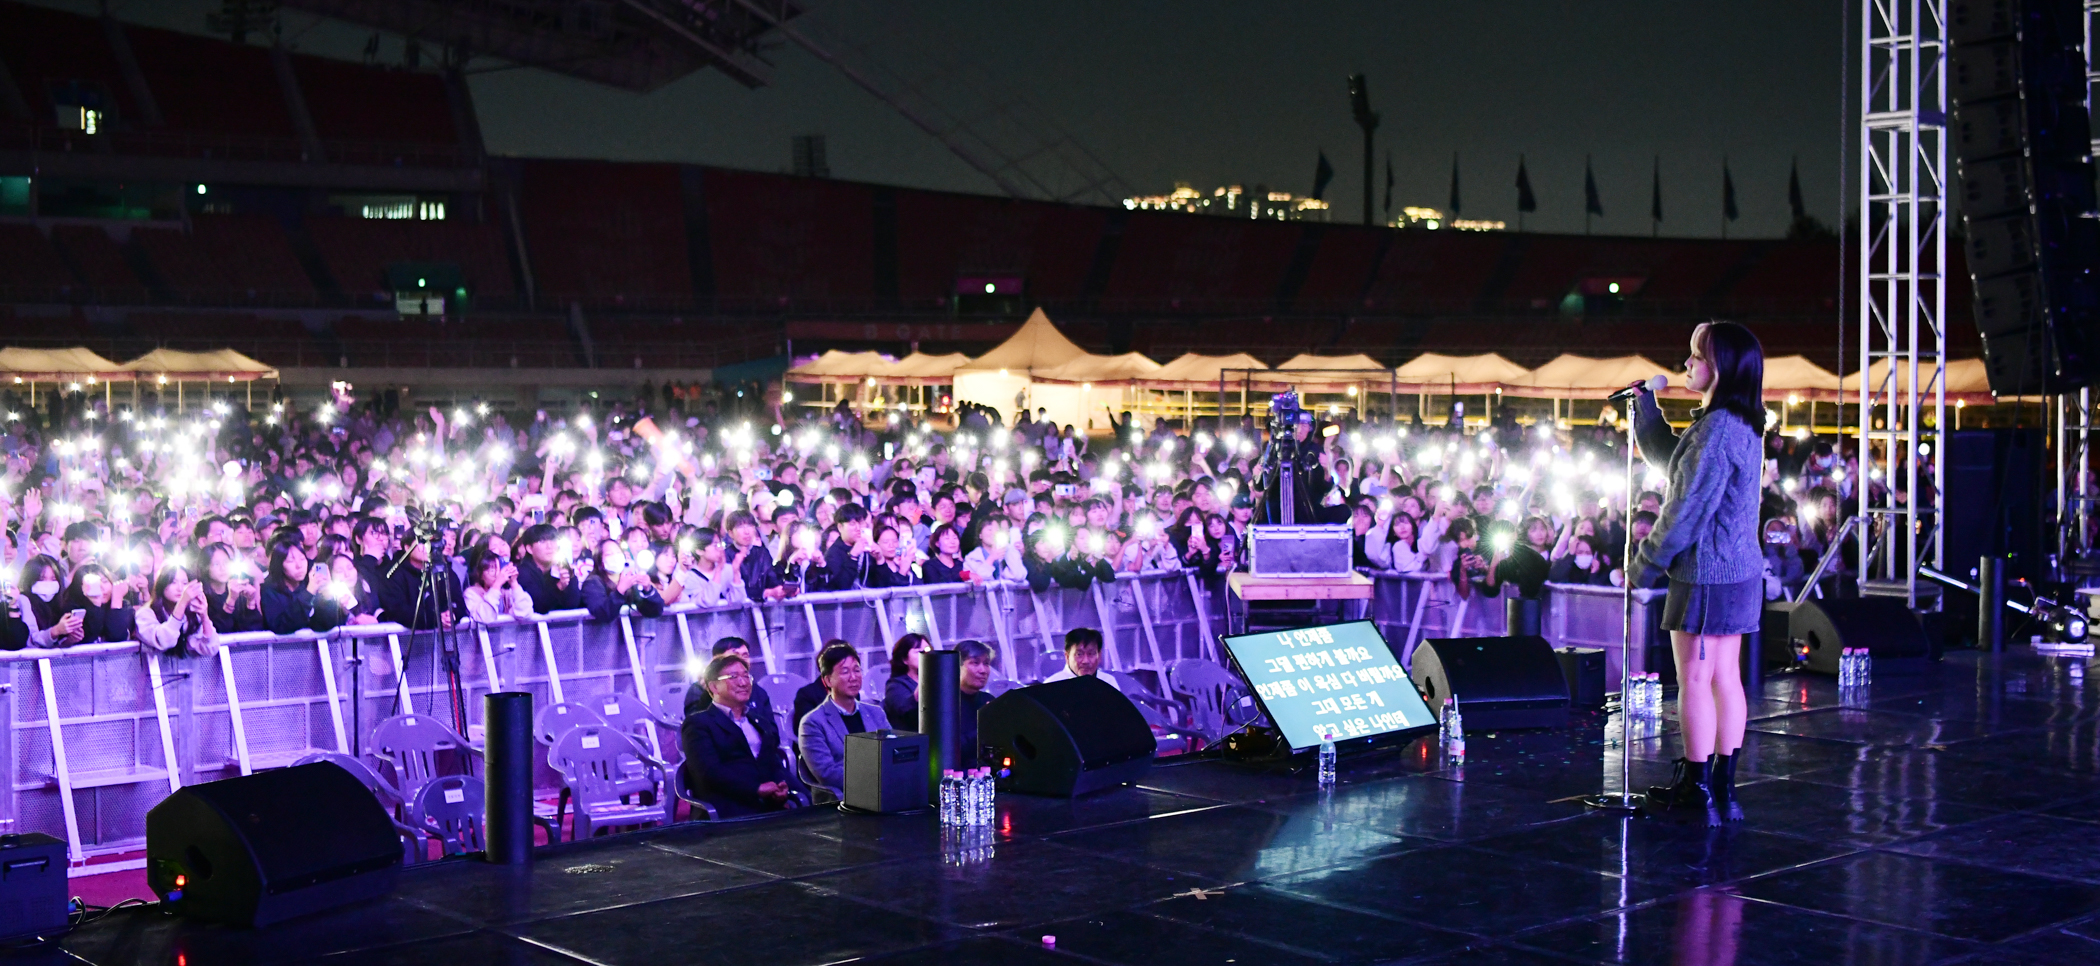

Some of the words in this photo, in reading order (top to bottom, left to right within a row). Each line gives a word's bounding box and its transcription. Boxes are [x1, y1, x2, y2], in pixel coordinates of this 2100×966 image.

[896, 324, 962, 340] GATE
[1276, 633, 1295, 649] 나
[1292, 650, 1335, 671] 편하게
[1332, 646, 1373, 665] 볼까요
[1297, 676, 1315, 694] 이
[1313, 672, 1343, 691] 욕심
[1340, 670, 1358, 687] 다
[1356, 664, 1407, 685] 버릴까요
[1311, 697, 1342, 715] 그대
[1339, 693, 1368, 711] 모든
[1366, 690, 1385, 707] 게
[1342, 717, 1371, 737] 싶은
